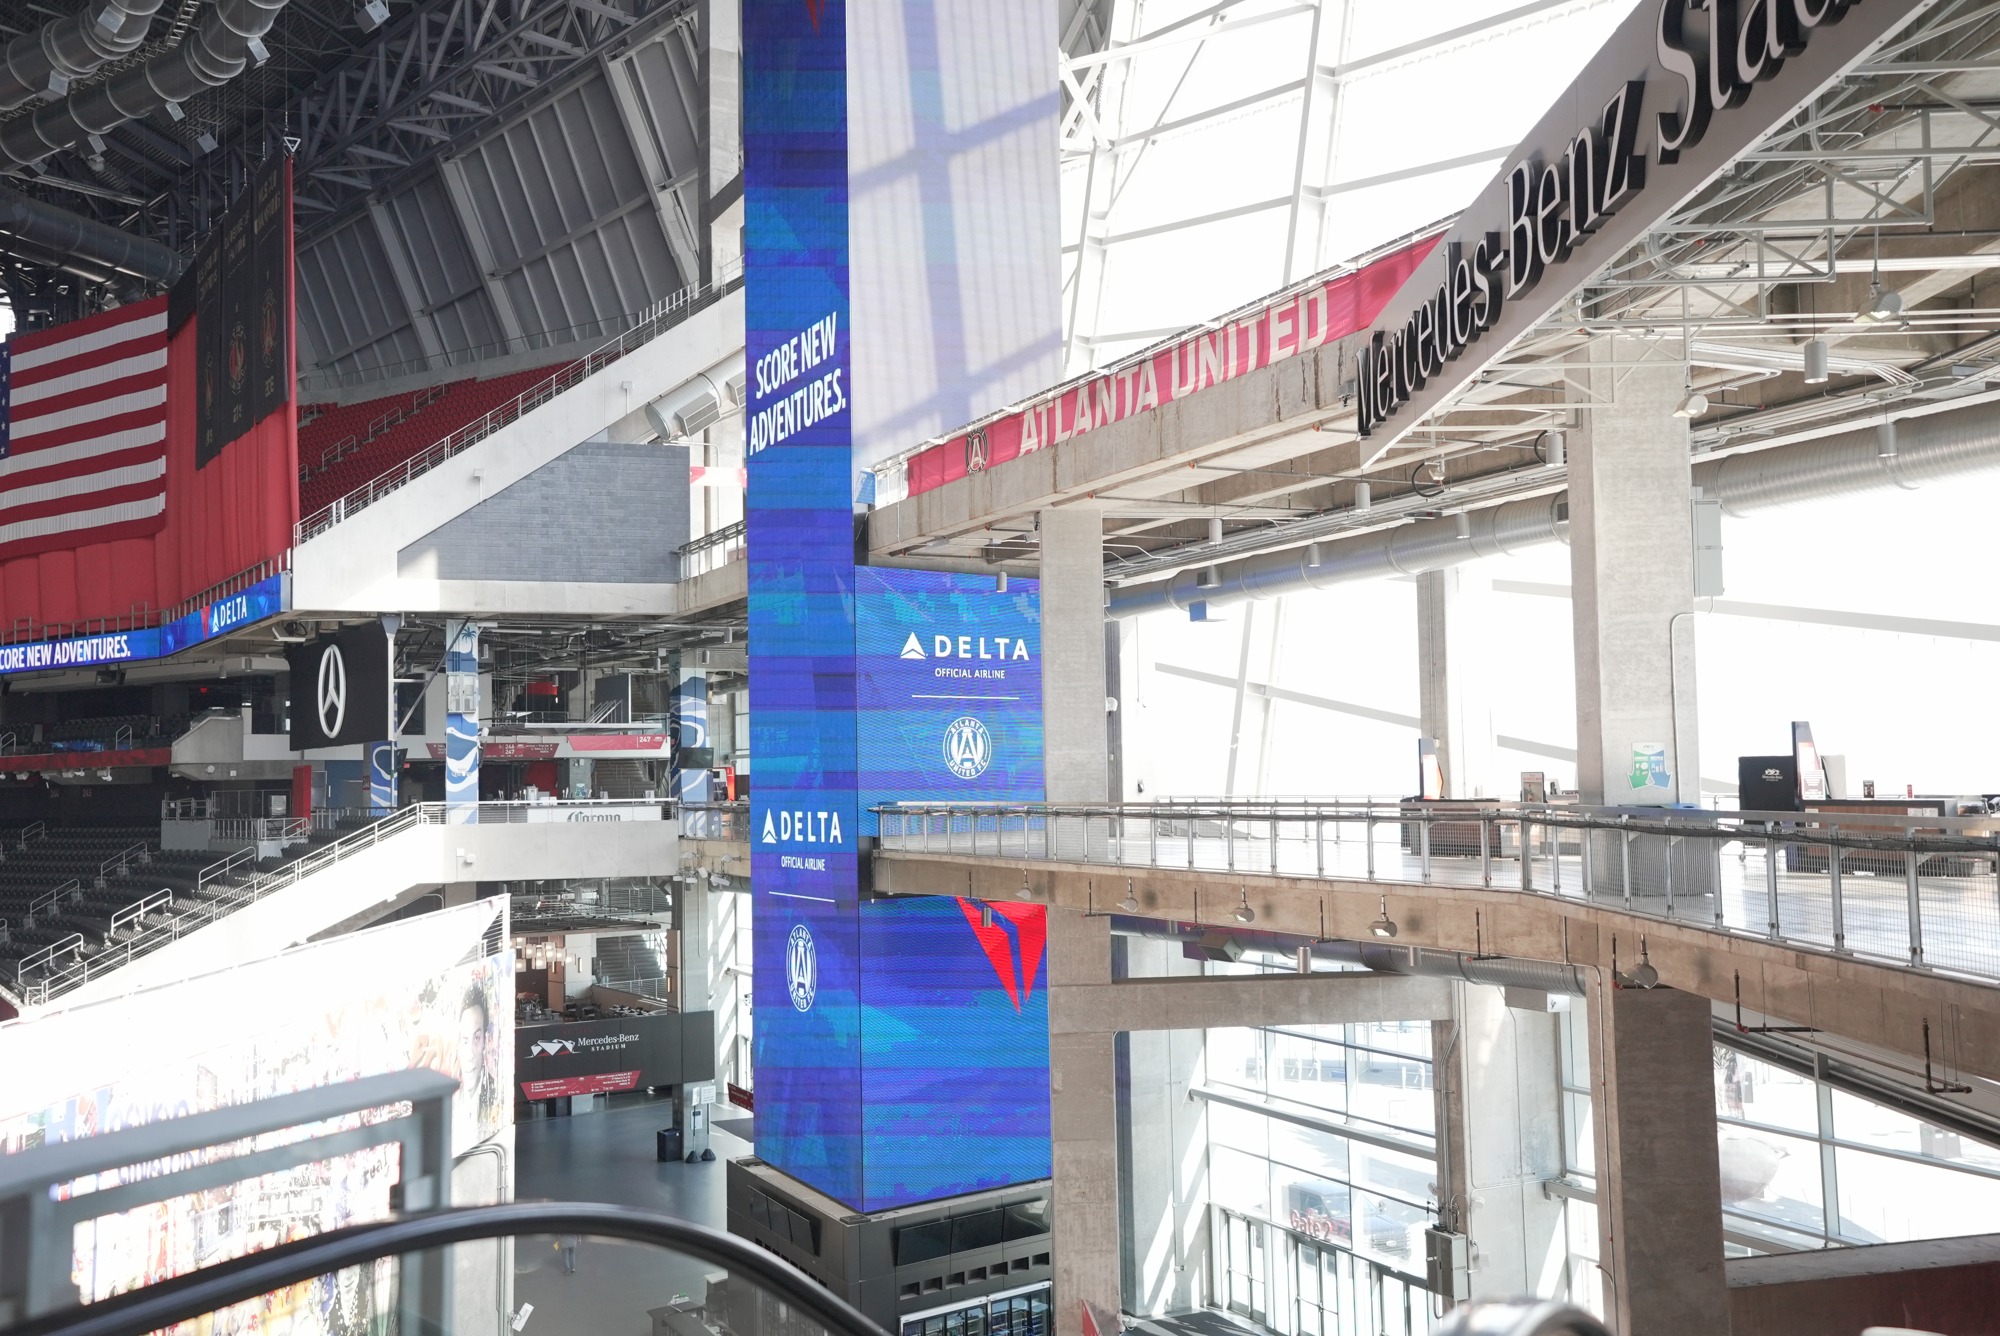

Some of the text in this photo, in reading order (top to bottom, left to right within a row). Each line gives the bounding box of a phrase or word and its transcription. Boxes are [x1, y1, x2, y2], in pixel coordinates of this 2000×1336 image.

[1356, 0, 1862, 437] Mercedes-Benz Sta
[756, 311, 837, 399] SCORE NEW
[1018, 284, 1329, 457] ATLANTA UNITED
[749, 368, 846, 456] ADVENTURES.
[220, 595, 248, 627] DELTA
[27, 643, 53, 668] NEW
[54, 635, 131, 664] ADVENTURES.
[934, 635, 1030, 661] DELTA
[934, 667, 1006, 680] OFFICIAL AIRLINE
[949, 719, 984, 734] ATLANTA
[949, 760, 987, 777] UNITED FC
[780, 811, 842, 844] DELTA
[781, 855, 826, 872] OFFICIAL AIRLINE
[790, 927, 813, 950] ATLANTA
[790, 983, 807, 1009] UNITED
[577, 1033, 640, 1047] Mercedes-Benz
[591, 1043, 627, 1052] STADIUM
[1290, 1209, 1334, 1243] Gate 2
